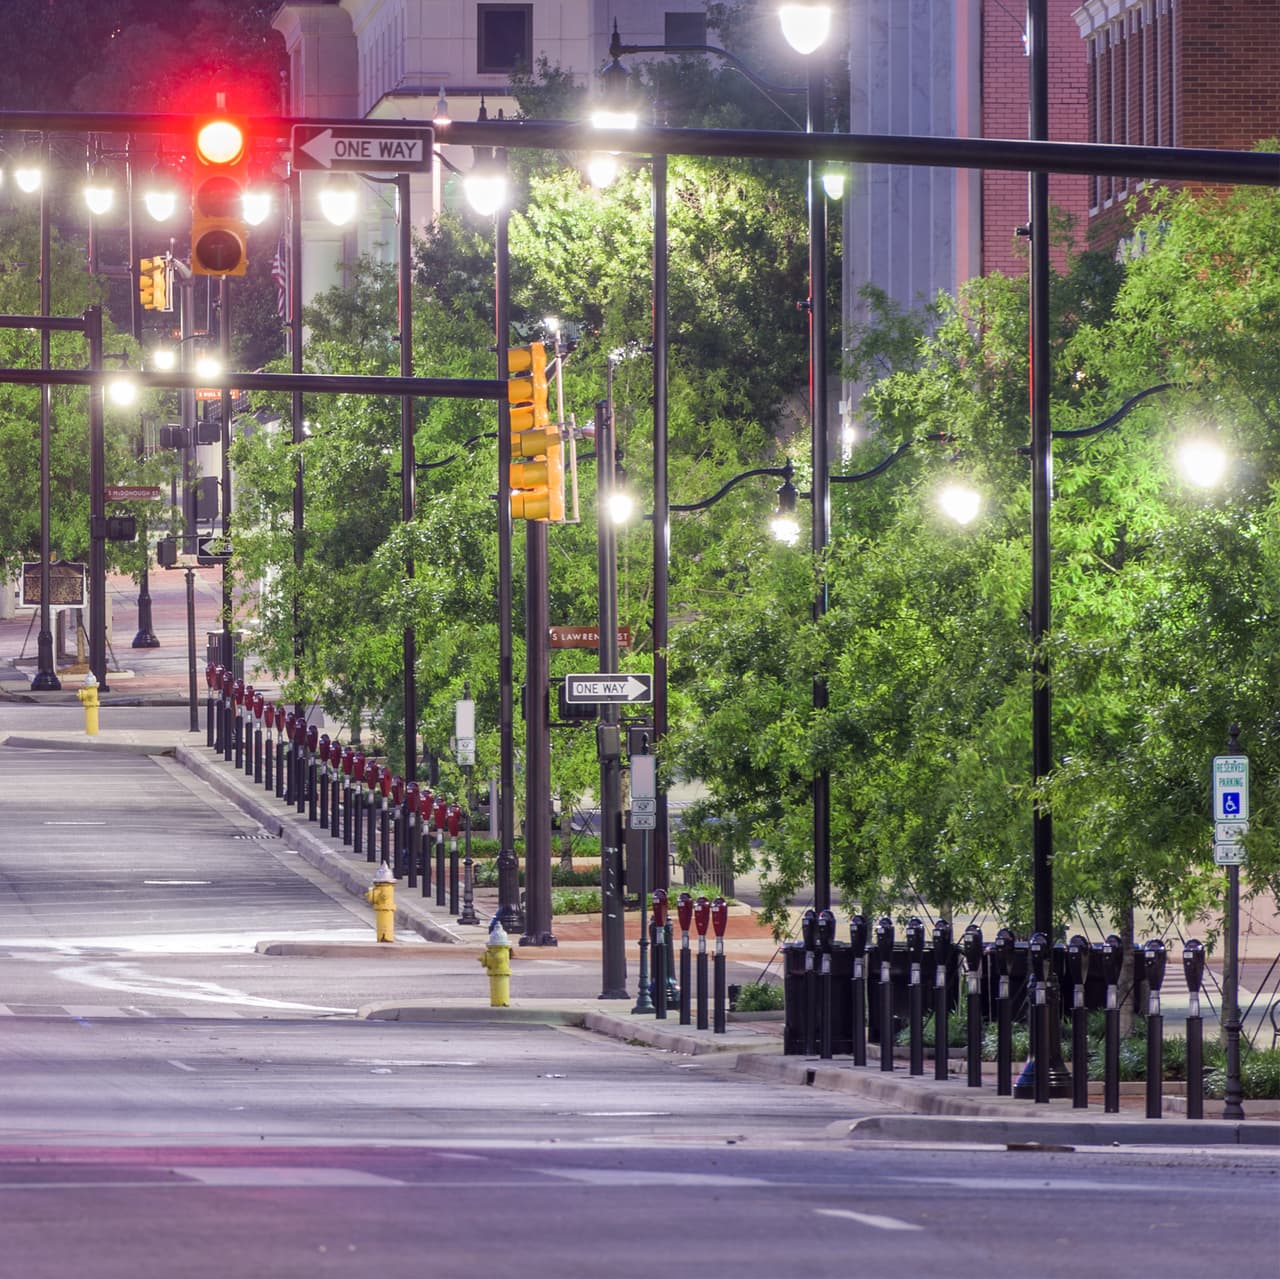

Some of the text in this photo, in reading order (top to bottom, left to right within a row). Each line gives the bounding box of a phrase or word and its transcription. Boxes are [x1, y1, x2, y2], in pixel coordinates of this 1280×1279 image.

[334, 140, 417, 159] ONE WAY
[552, 632, 558, 641] S
[561, 632, 600, 641] LAWREN
[576, 683, 626, 694] ONE WAY
